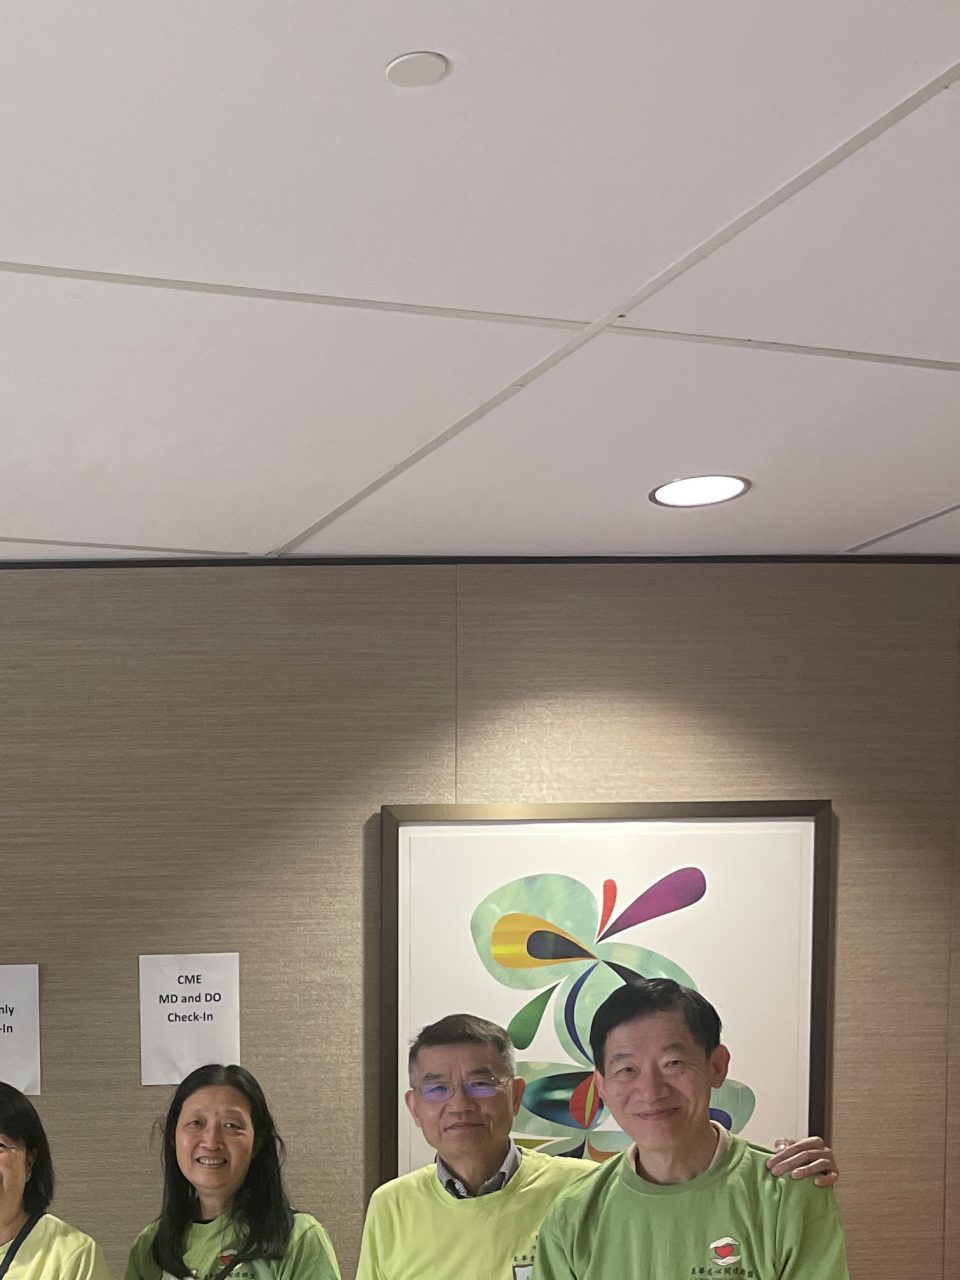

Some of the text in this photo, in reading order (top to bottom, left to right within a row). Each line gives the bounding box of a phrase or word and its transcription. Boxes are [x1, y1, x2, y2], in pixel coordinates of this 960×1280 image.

[177, 974, 203, 986] CME
[158, 992, 222, 1005] MD and DO
[167, 1011, 214, 1023] Check-In
